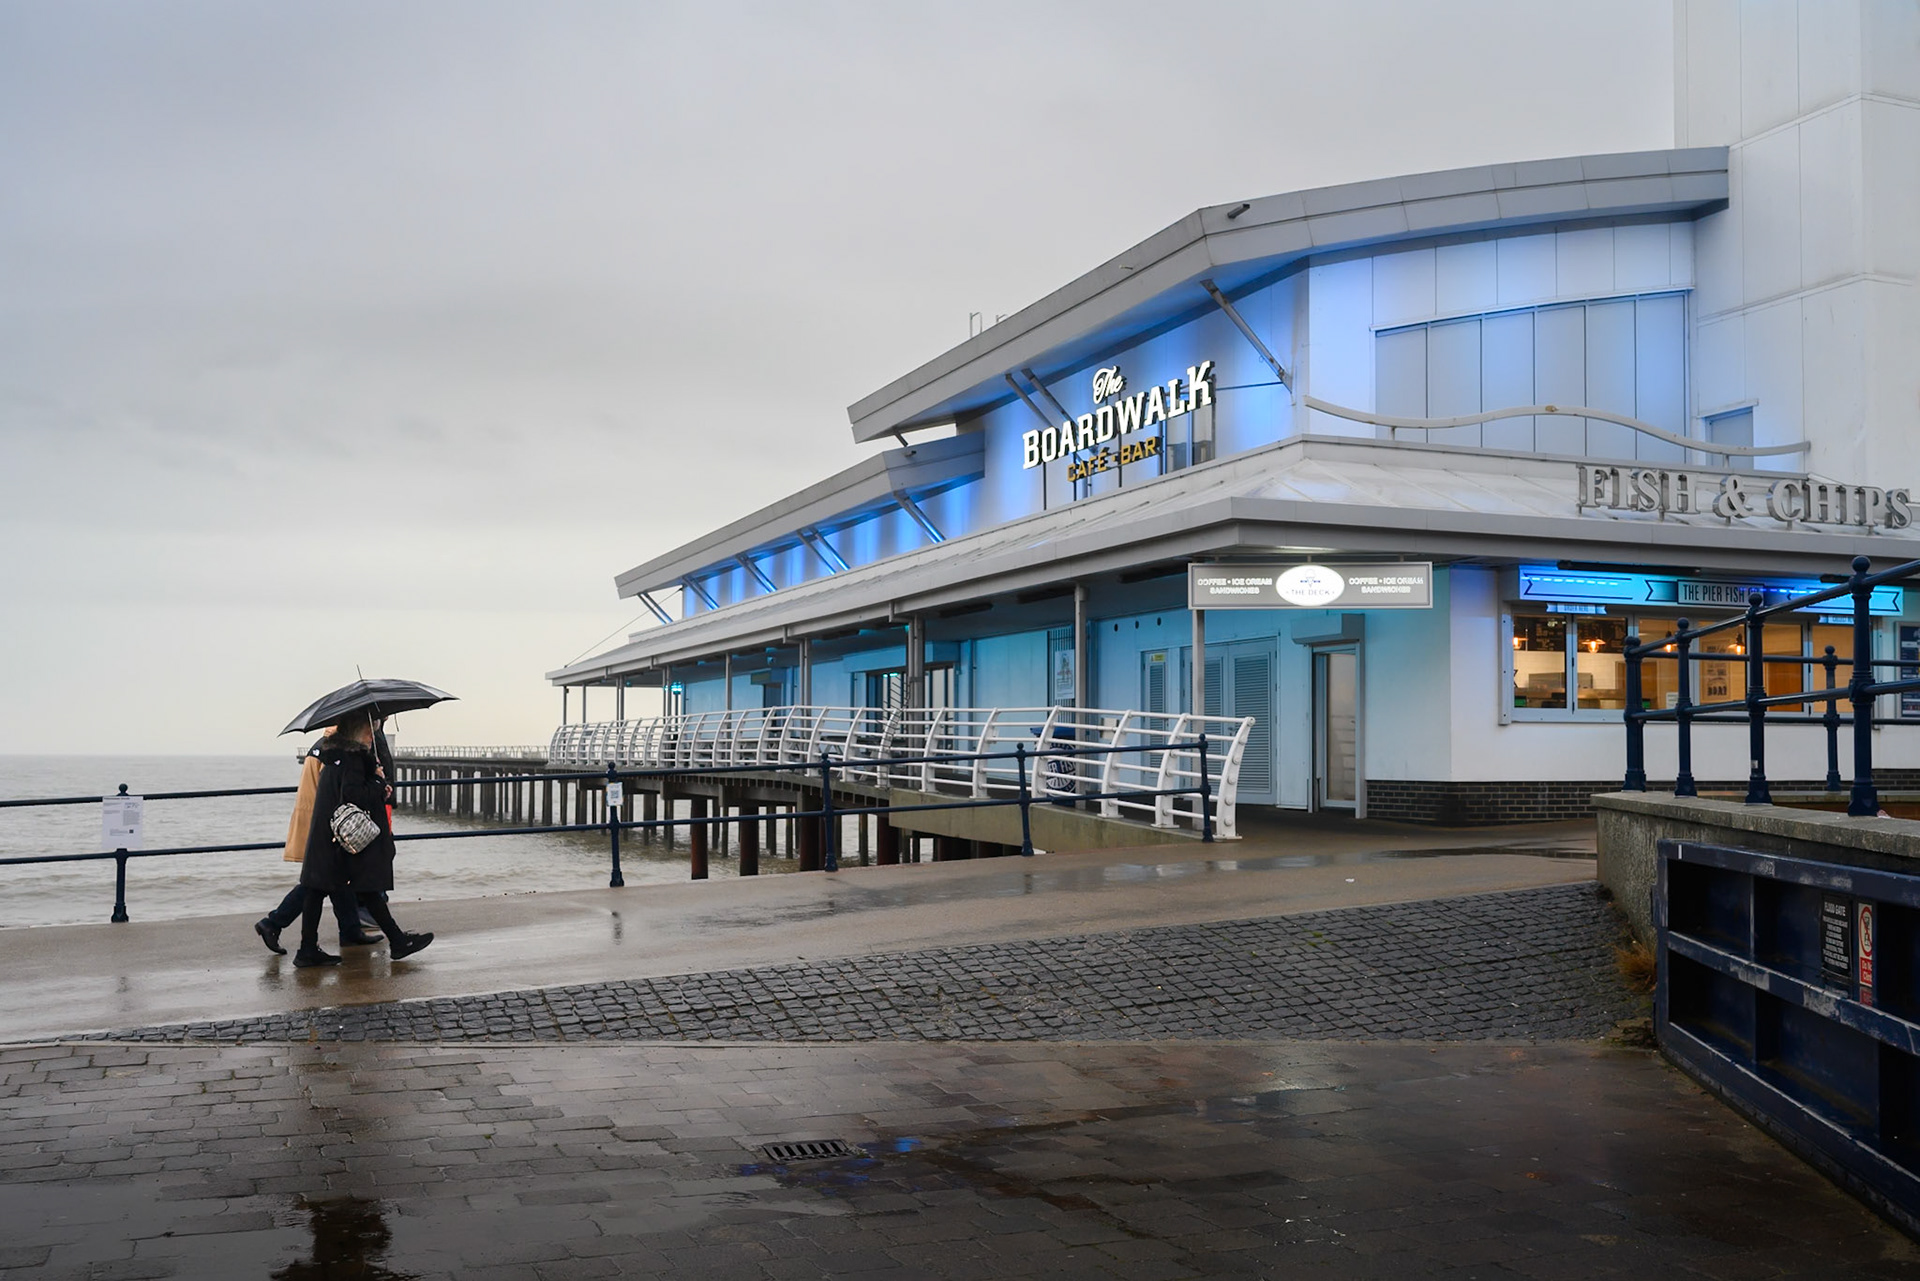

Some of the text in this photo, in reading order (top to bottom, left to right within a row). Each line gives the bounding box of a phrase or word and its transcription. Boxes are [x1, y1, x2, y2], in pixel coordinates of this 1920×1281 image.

[1093, 365, 1124, 404] The
[1022, 360, 1212, 469] BOARDWALK
[1121, 436, 1157, 465] BAR
[1577, 464, 1913, 530] FISH & CHIPS
[1198, 578, 1273, 586] COFFEE ICE CREAM
[1349, 577, 1424, 585] COFFEE ICE CREAM
[1361, 586, 1412, 594] SANDWICHES
[1209, 587, 1260, 595] SANDWICHES
[1683, 584, 1700, 601] THE
[1702, 585, 1723, 602] PIER
[1725, 586, 1745, 603] FISH
